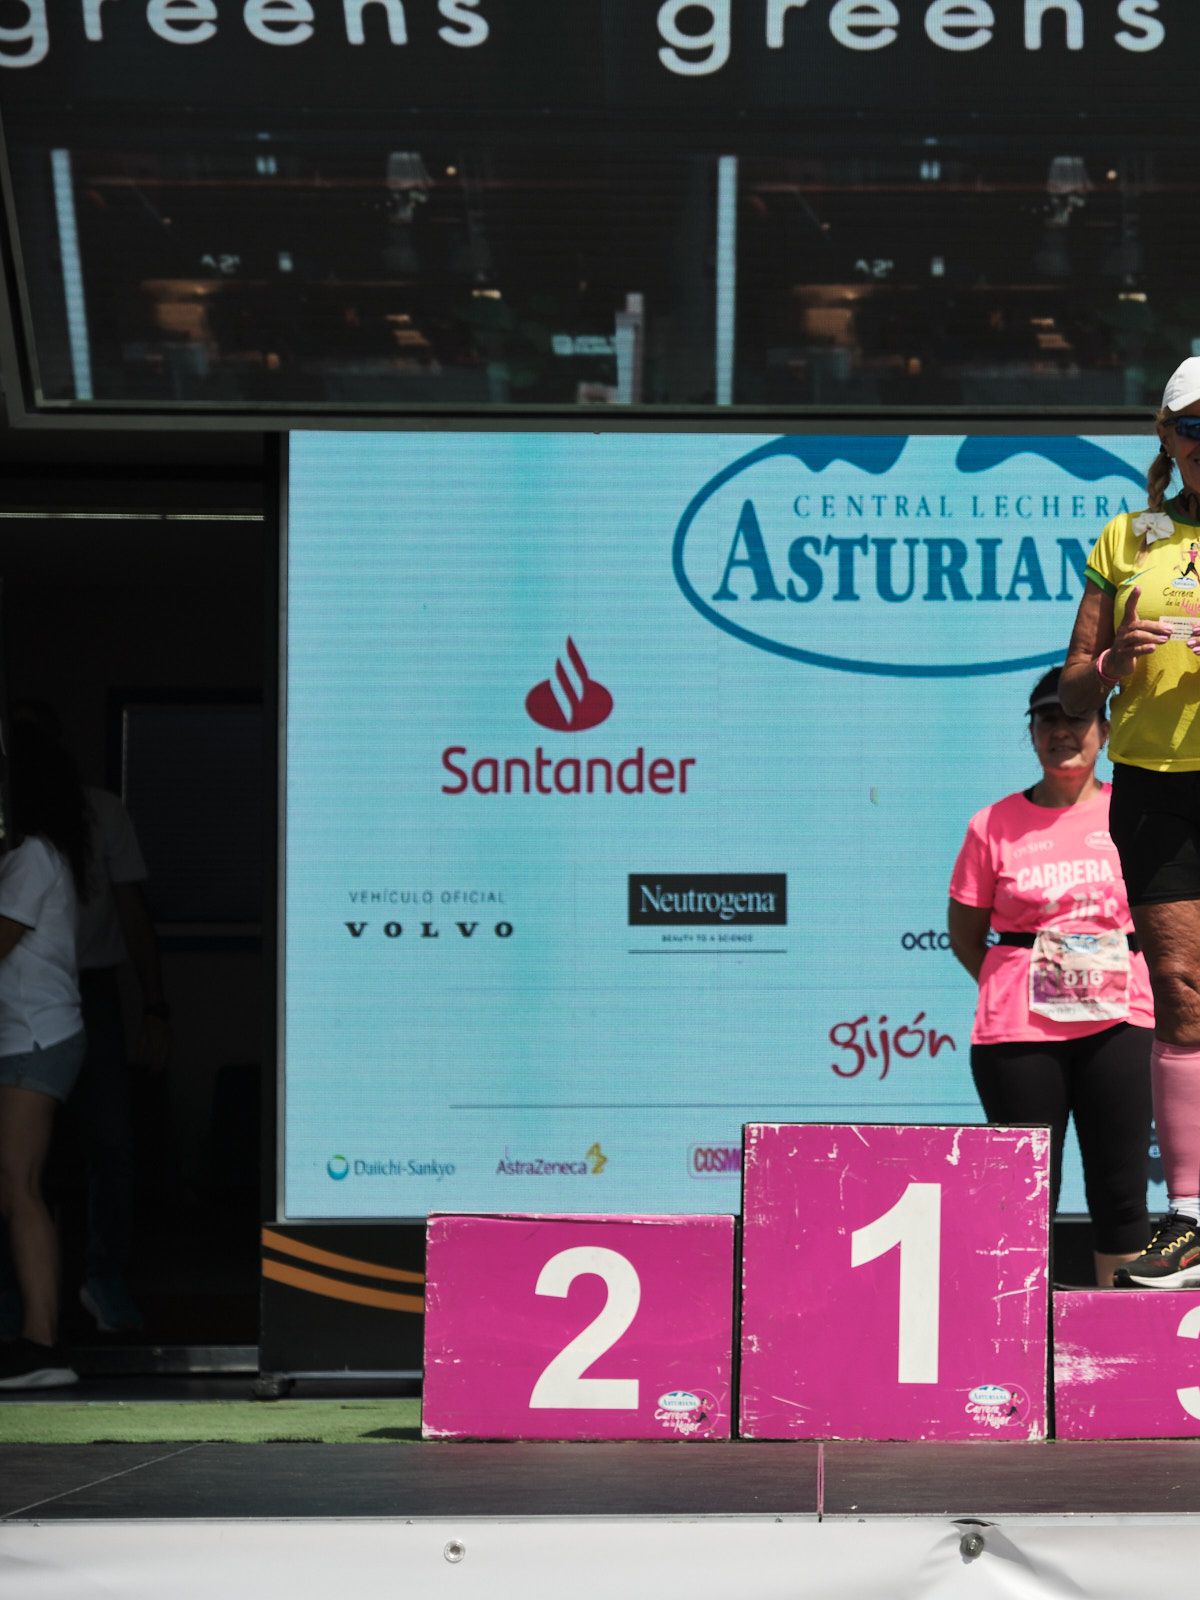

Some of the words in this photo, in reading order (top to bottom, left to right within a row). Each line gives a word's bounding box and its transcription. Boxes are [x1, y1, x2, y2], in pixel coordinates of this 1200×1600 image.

[0, 0, 490, 68] greens
[656, 0, 1166, 77] greens
[793, 495, 953, 519] CENTRAL
[971, 495, 1131, 519] LECHERA
[712, 499, 1096, 604] ASTURIAN
[441, 745, 696, 795] Santander
[440, 890, 504, 904] OFICIAL
[1016, 858, 1115, 892] CARRERA
[639, 884, 776, 921] Neutrogena
[344, 921, 513, 938] VOLVO
[829, 1011, 957, 1081] gijón
[496, 1158, 588, 1175] AstraZeneca
[850, 1182, 942, 1384] 1
[529, 1245, 641, 1410] 2
